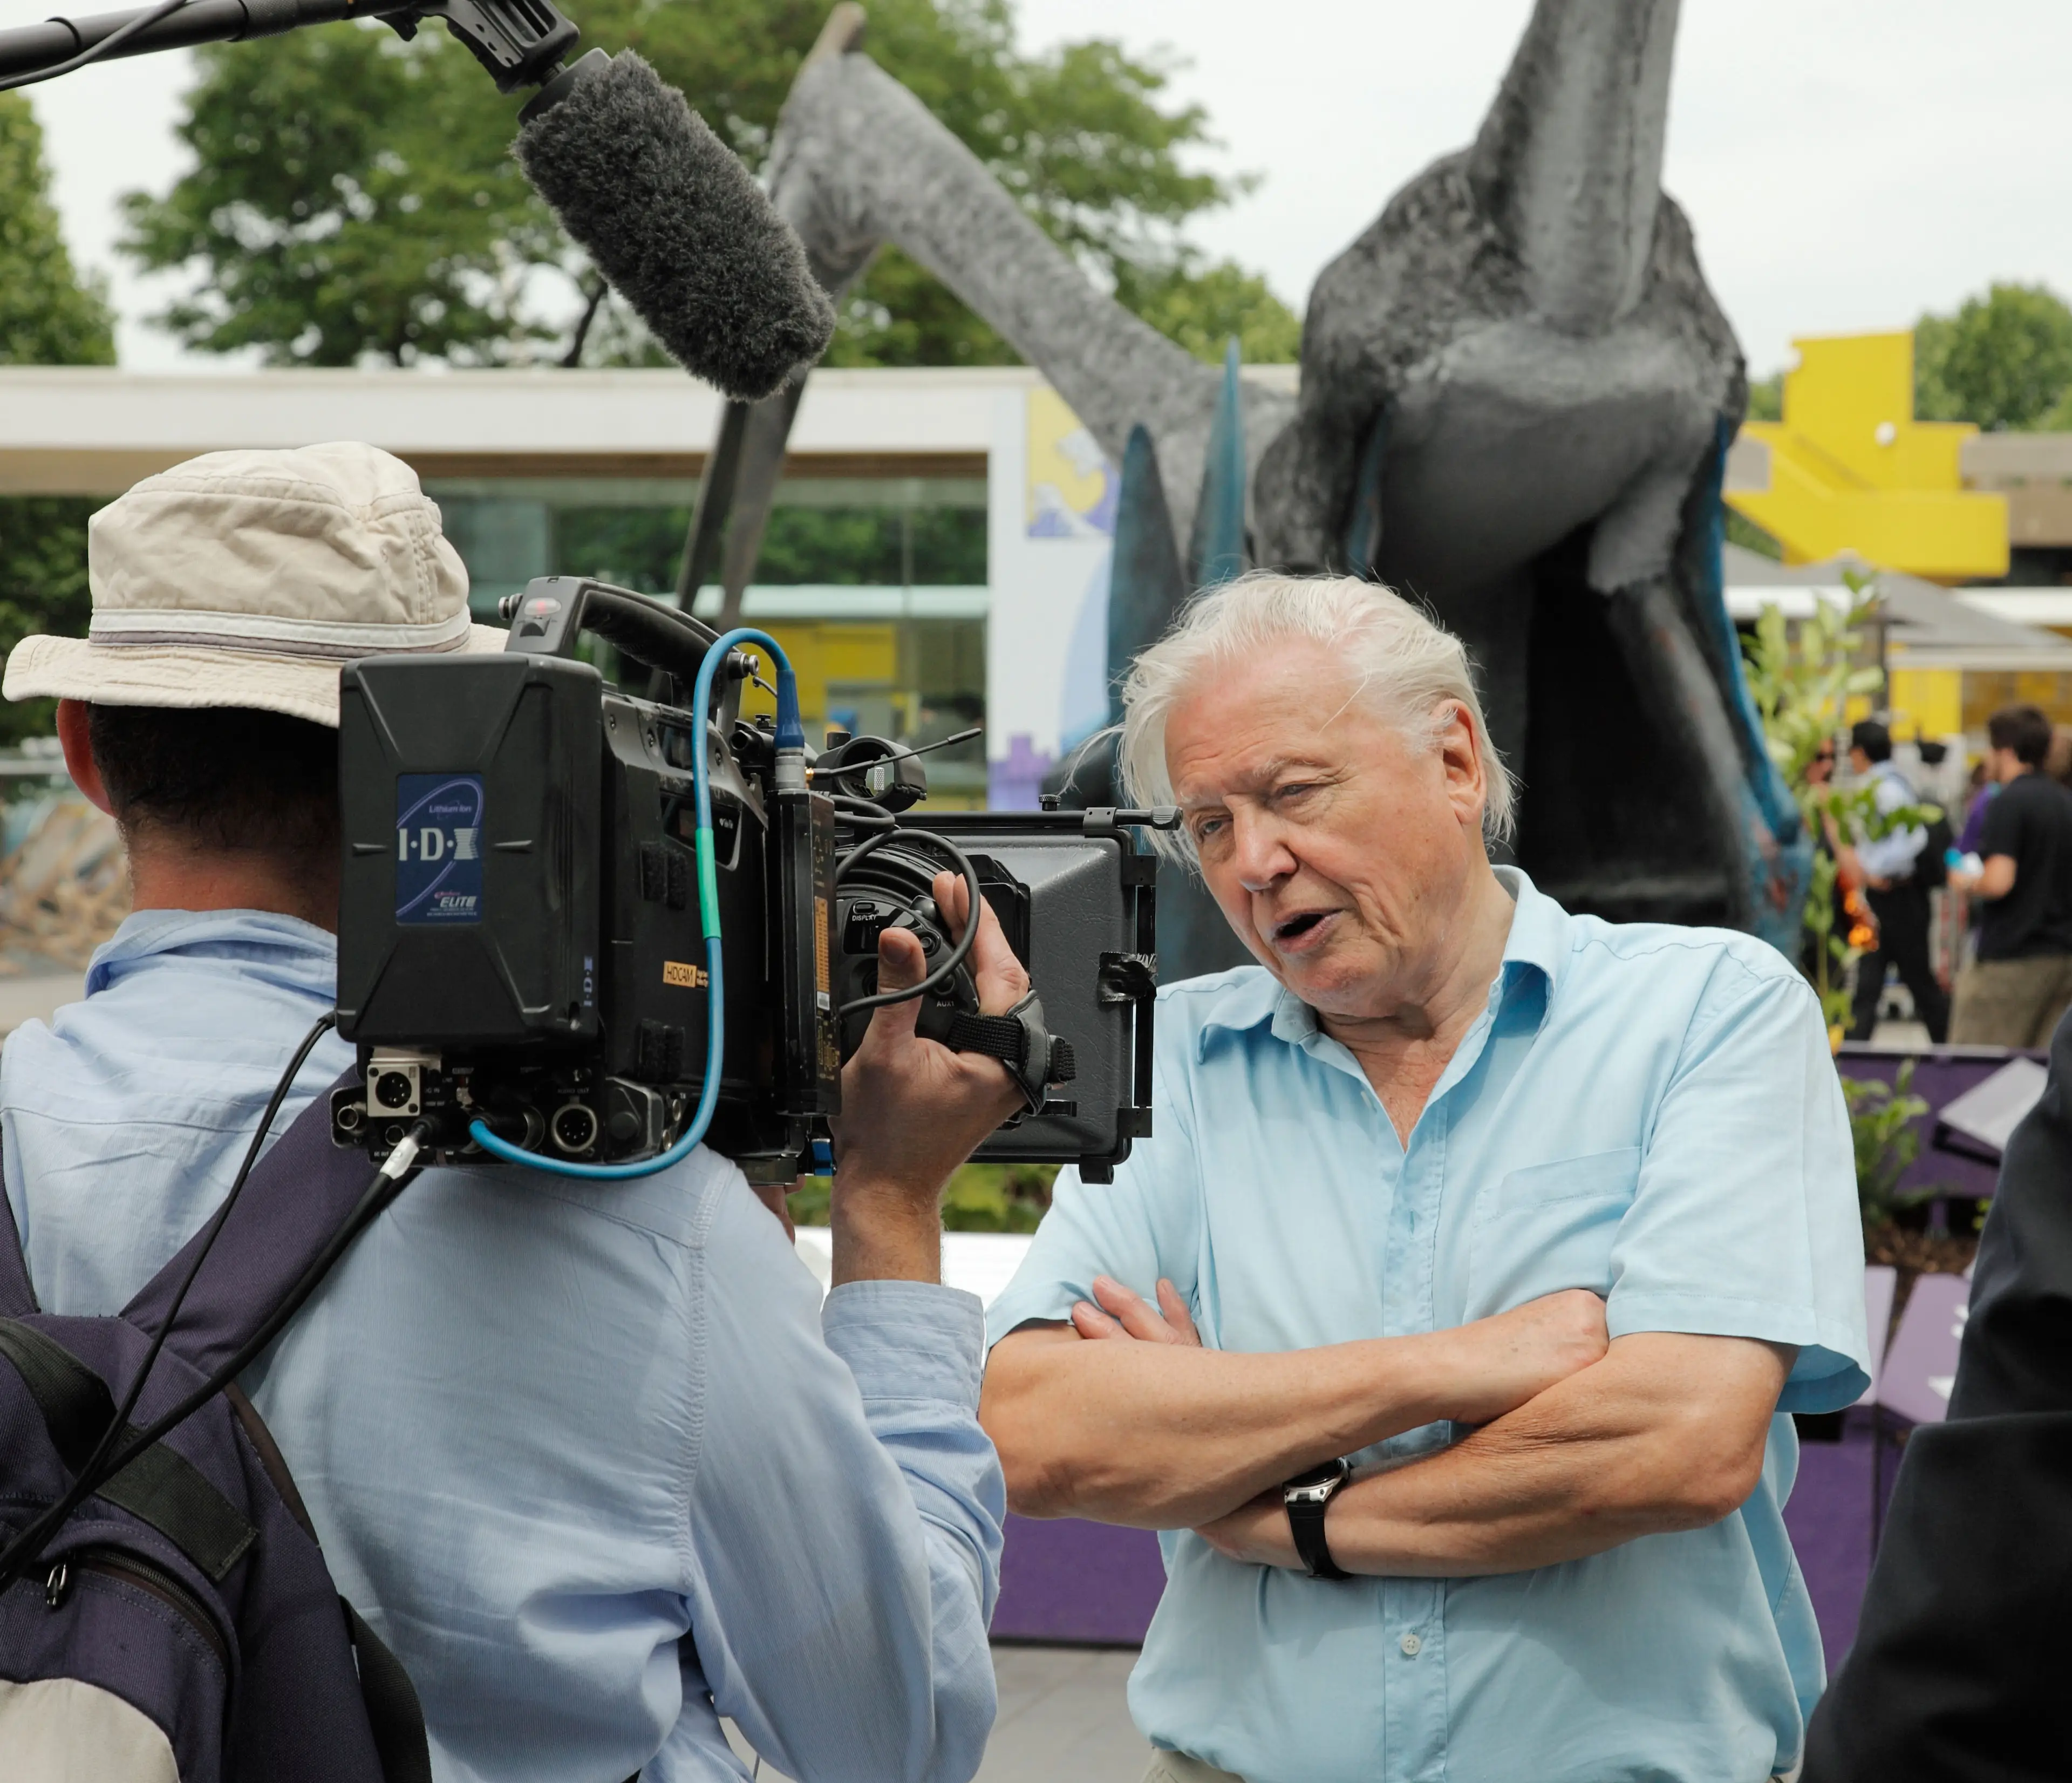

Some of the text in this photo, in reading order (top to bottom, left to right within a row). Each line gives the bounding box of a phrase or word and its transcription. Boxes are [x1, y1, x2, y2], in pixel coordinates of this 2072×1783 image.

[429, 805, 458, 813] Lithium
[440, 896, 477, 908] ELITE
[666, 965, 693, 984] HDCAM
